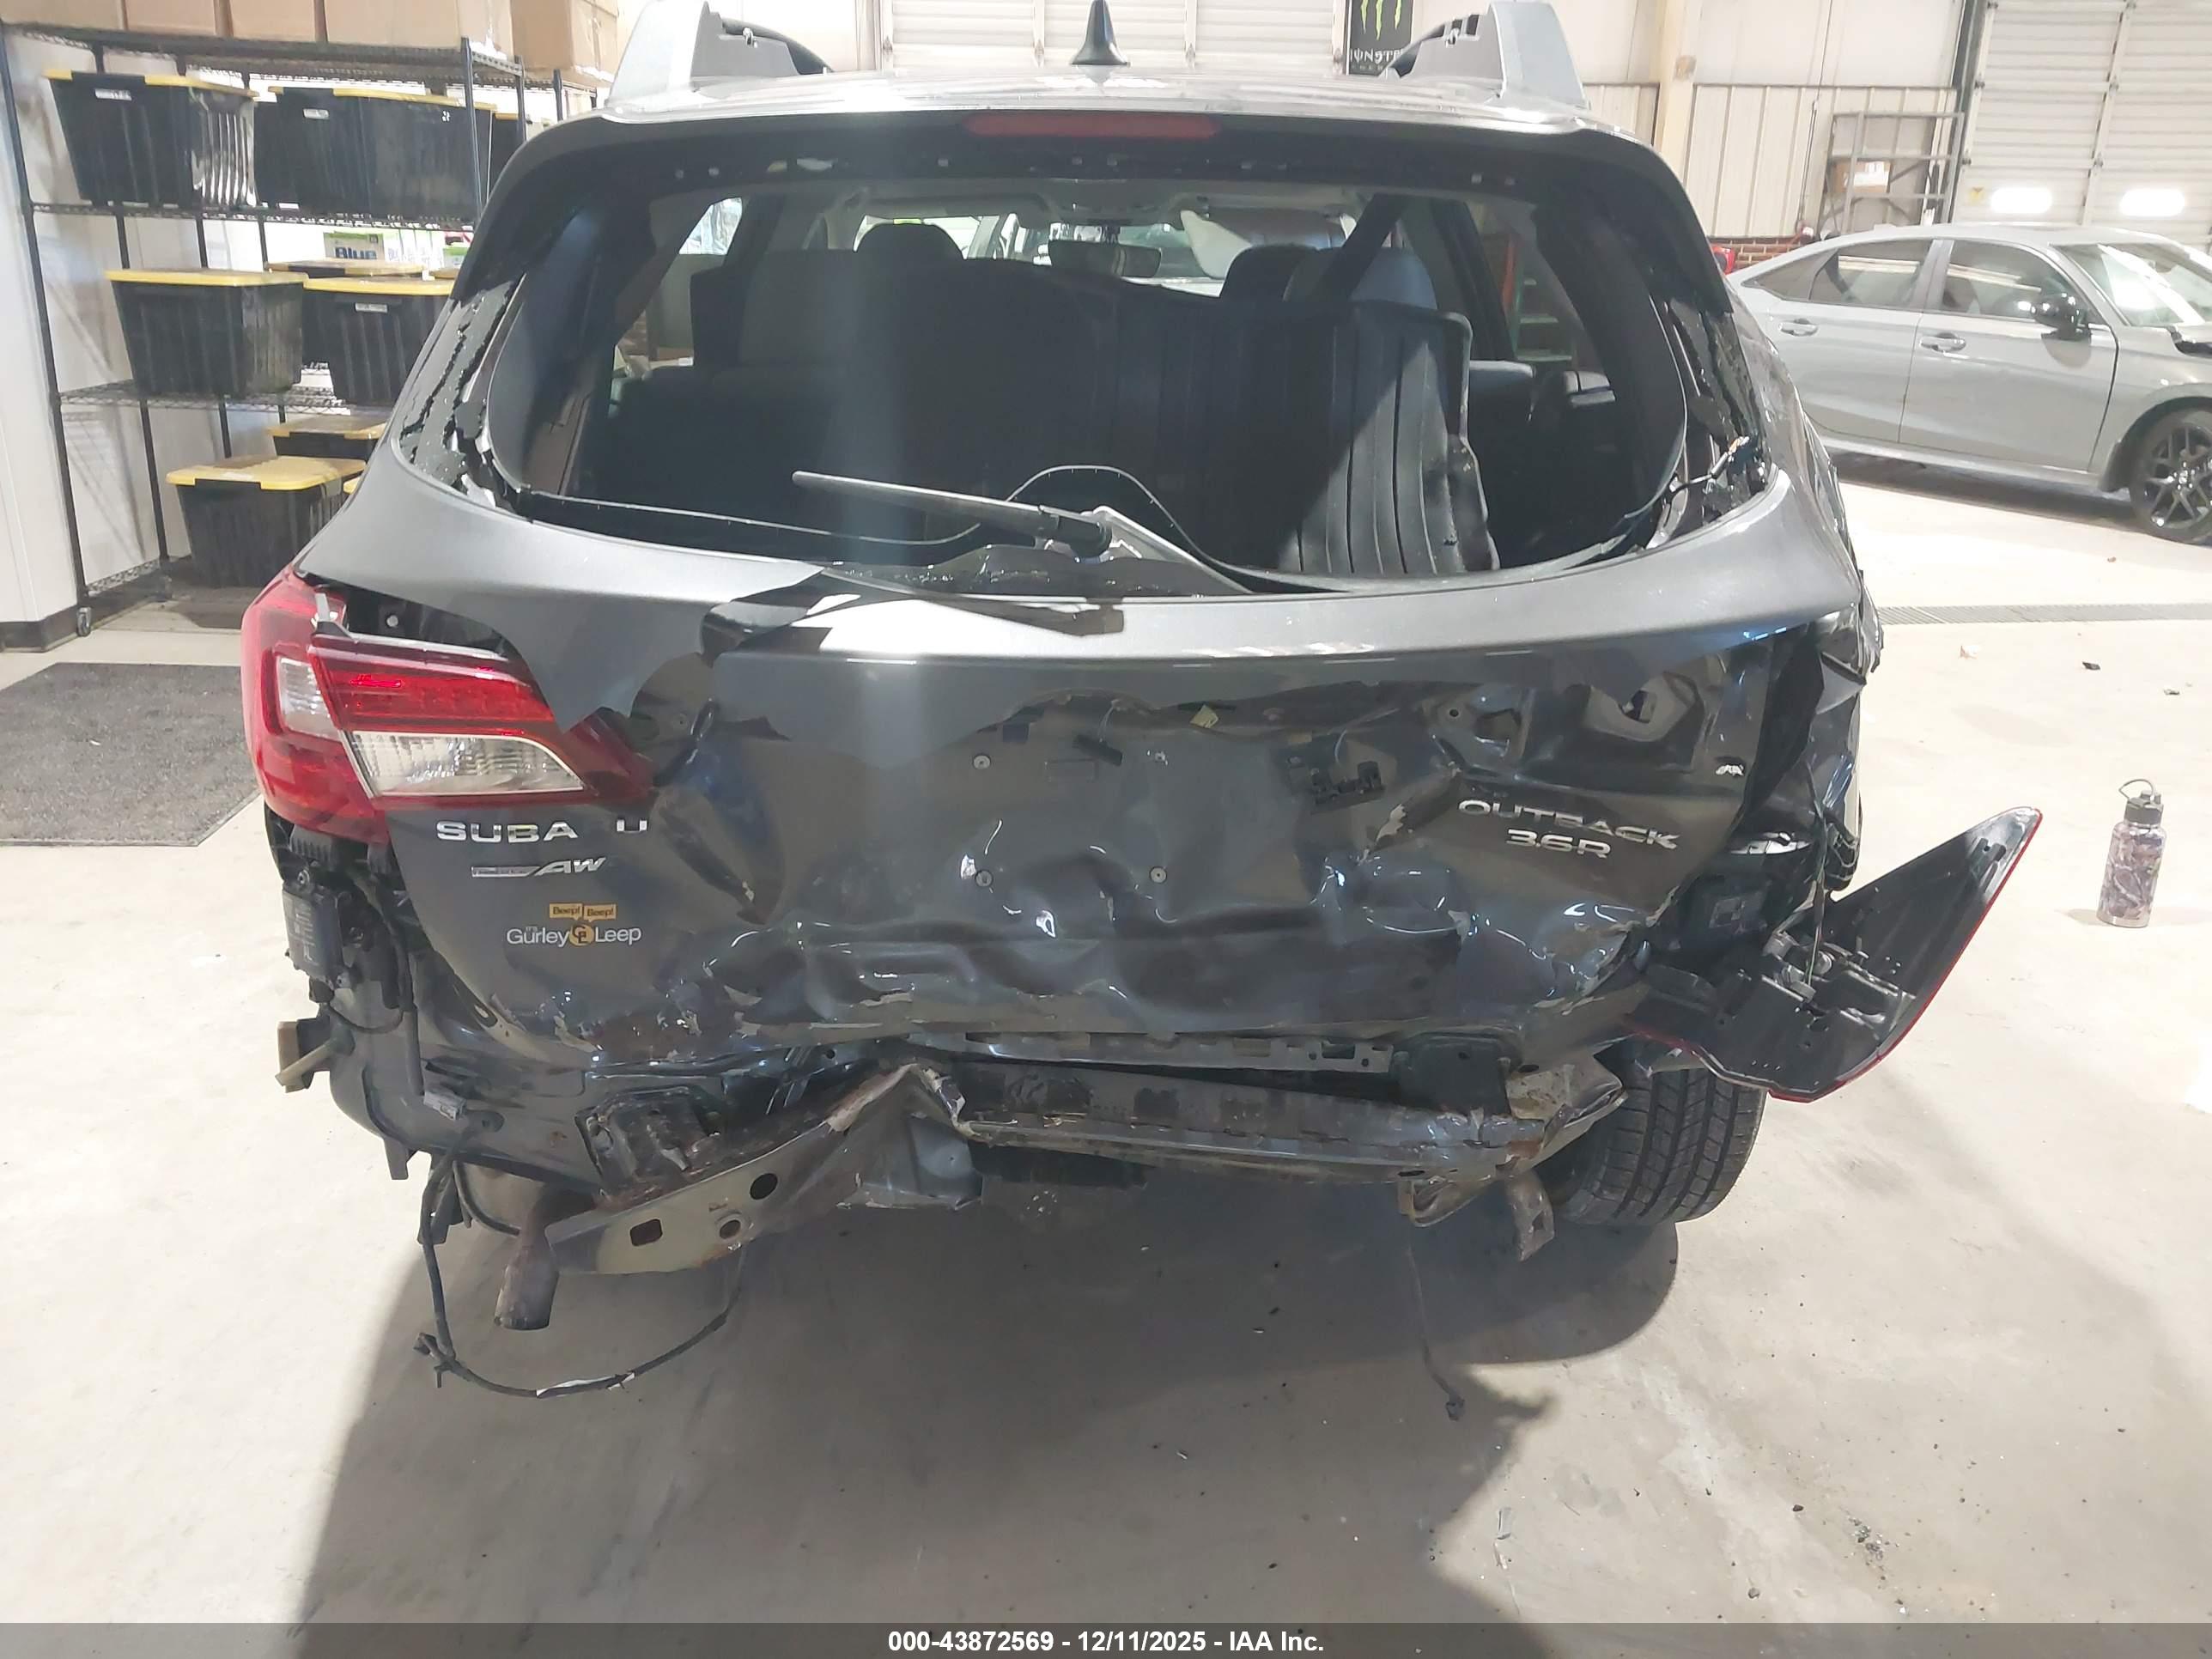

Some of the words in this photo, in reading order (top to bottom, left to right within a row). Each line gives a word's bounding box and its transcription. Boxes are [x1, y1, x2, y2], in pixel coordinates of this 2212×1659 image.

[552, 905, 580, 915] Beep!
[586, 907, 615, 918] Beep!
[506, 927, 570, 947] Gurley
[594, 926, 642, 945] Leep
